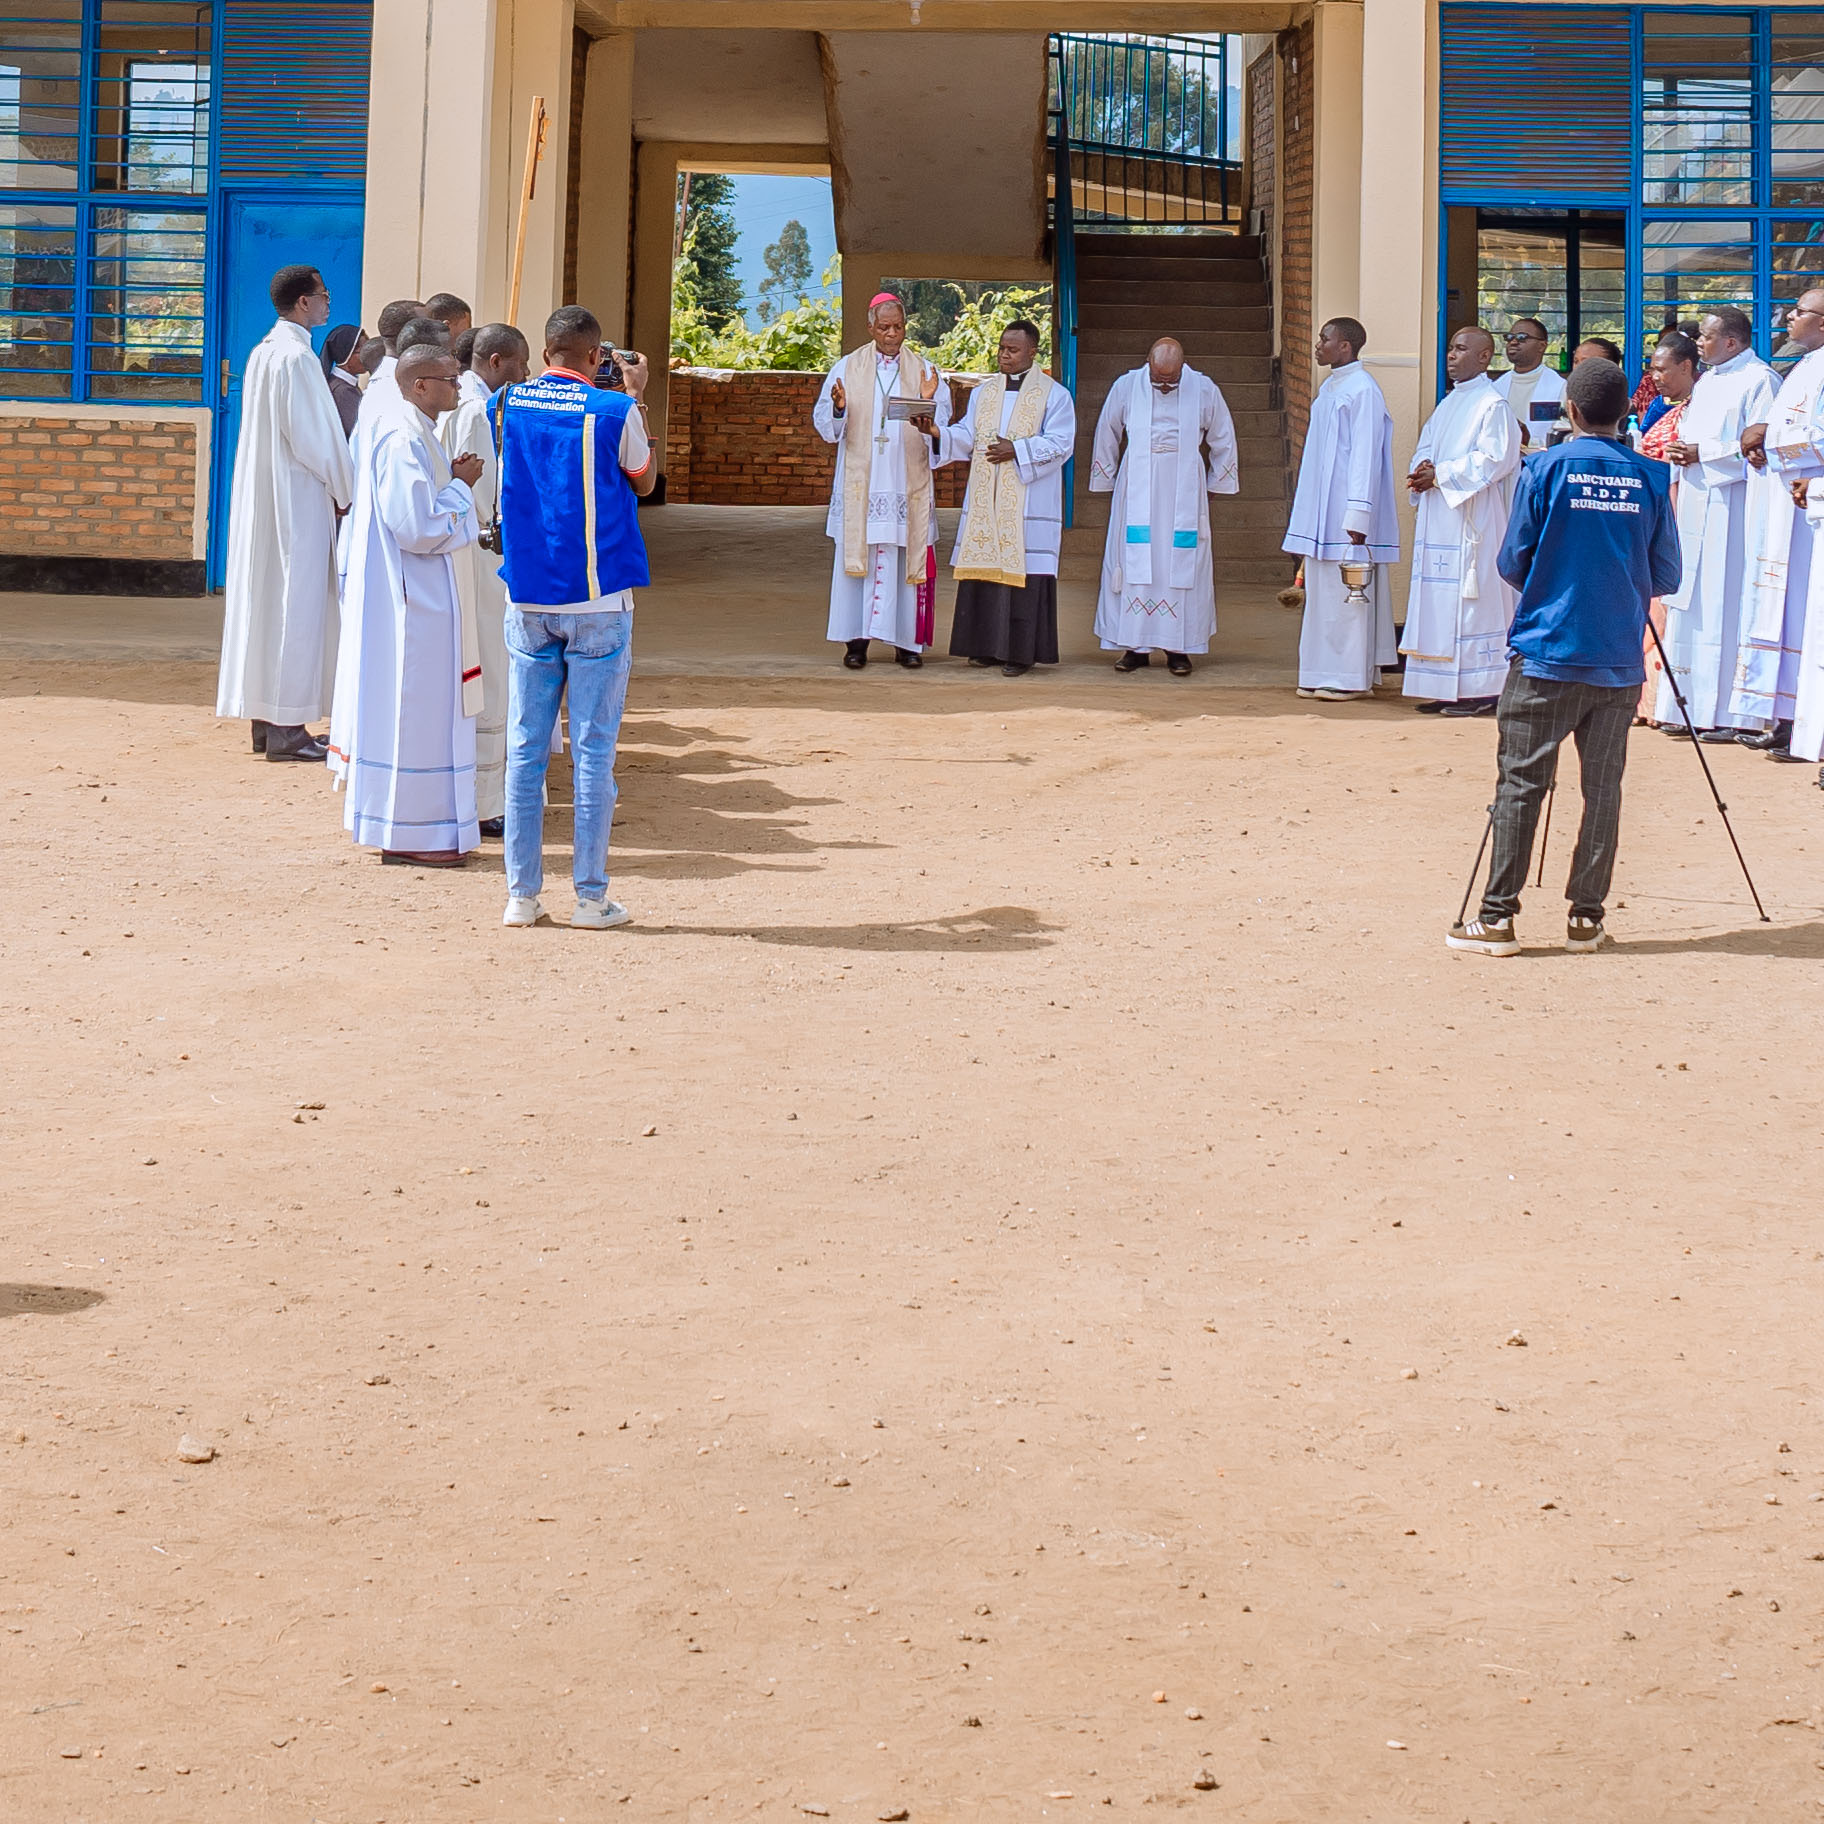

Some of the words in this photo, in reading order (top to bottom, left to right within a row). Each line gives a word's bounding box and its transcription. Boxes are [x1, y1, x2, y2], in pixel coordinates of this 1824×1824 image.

[512, 386, 588, 402] RUHENGERI
[508, 396, 585, 412] Communication
[1567, 473, 1643, 489] SANCTUAIRE
[1569, 498, 1640, 514] RUHENGERI
